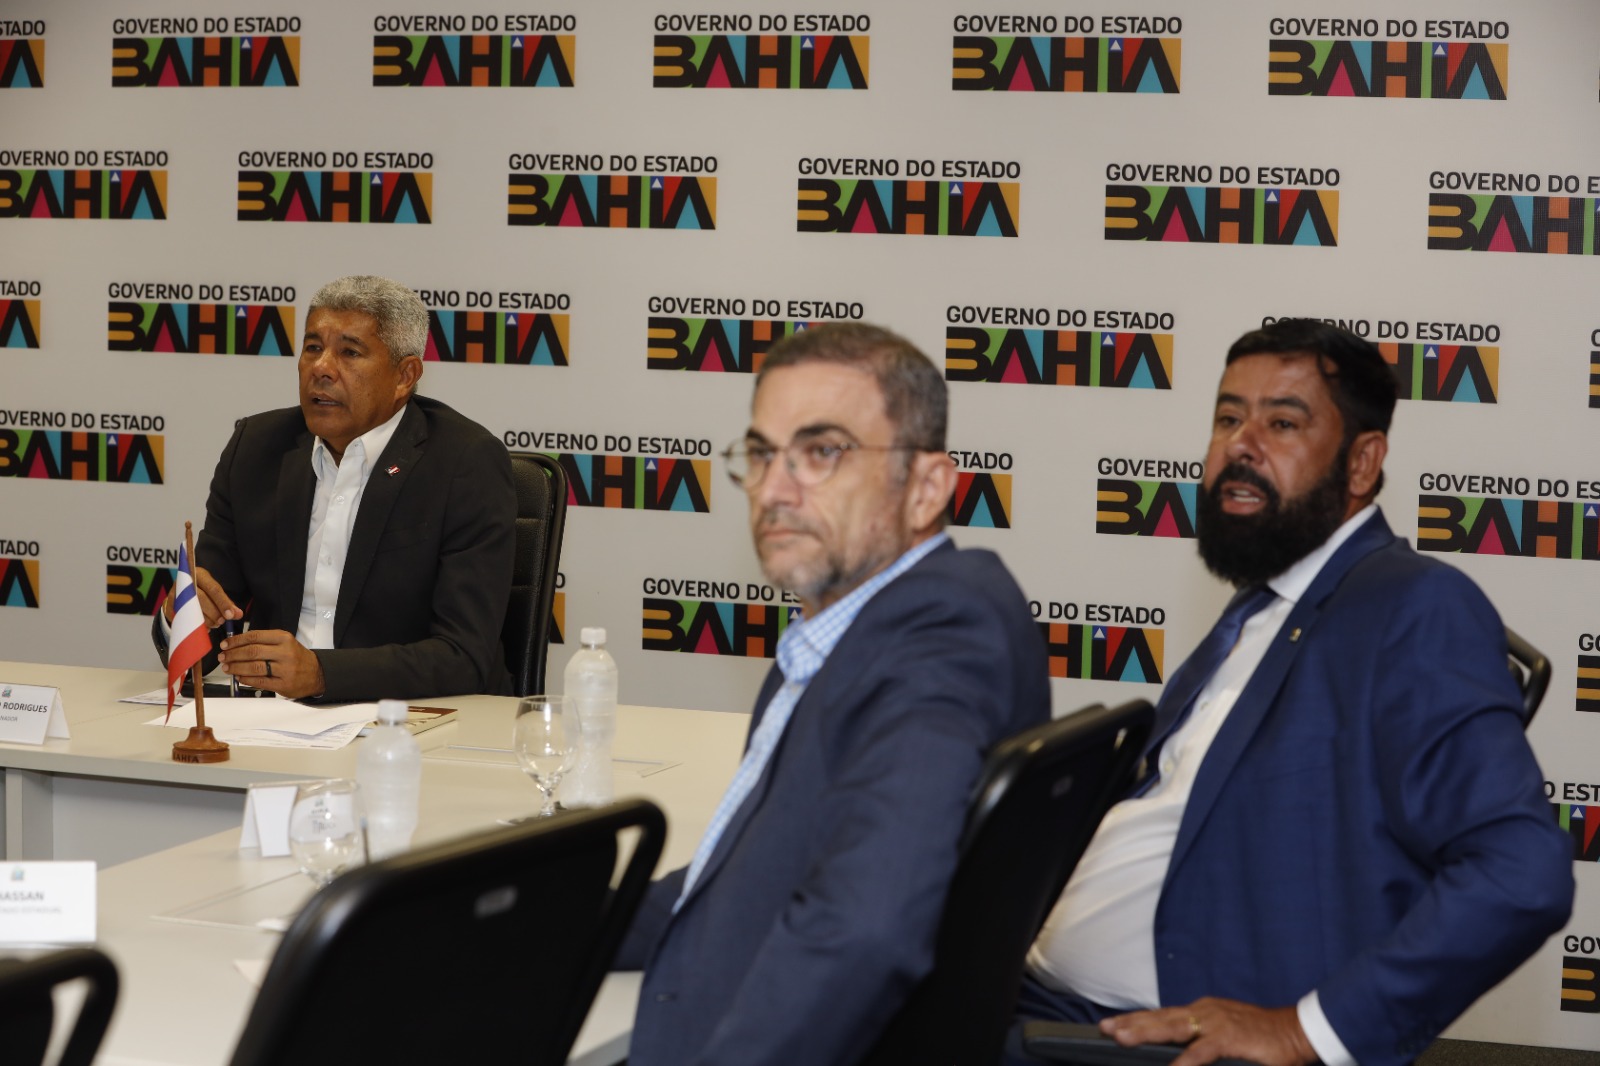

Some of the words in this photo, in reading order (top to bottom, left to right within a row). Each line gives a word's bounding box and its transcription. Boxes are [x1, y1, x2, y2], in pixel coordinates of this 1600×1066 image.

[113, 17, 199, 35] GOVERNO
[203, 16, 229, 34] DO
[234, 16, 302, 34] ESTADO
[373, 15, 467, 33] GOVERNO
[471, 15, 499, 32] DO
[504, 15, 577, 32] ESTADO
[654, 14, 753, 32] GOVERNO
[758, 14, 788, 32] DO
[793, 15, 871, 33] ESTADO
[953, 15, 1058, 34] GOVERNO
[1064, 15, 1095, 34] DO
[1101, 16, 1183, 35] ESTADO
[1269, 17, 1379, 37] GOVERNO
[1386, 19, 1418, 38] DO
[1424, 20, 1510, 40] ESTADO
[112, 36, 301, 88] BAHIA
[373, 34, 576, 88] BAHIA
[653, 35, 870, 90] BAHIA
[952, 36, 1182, 94] BAHIA
[1268, 39, 1510, 100] BAHIA
[0, 150, 70, 167] OVERNO
[74, 151, 99, 167] DO
[103, 151, 169, 168] ESTADO
[238, 151, 327, 169] GOVERNO
[332, 152, 359, 169] DO
[363, 152, 434, 170] ESTADO
[508, 153, 604, 172] GOVERNO
[609, 154, 638, 172] DO
[643, 155, 718, 174] ESTADO
[798, 157, 900, 177] GOVERNO
[905, 159, 936, 178] DO
[941, 160, 1021, 179] ESTADO
[1105, 164, 1213, 184] GOVERNO
[1219, 165, 1251, 185] DO
[1257, 167, 1340, 187] ESTADO
[1429, 171, 1541, 193] GOVERNO
[1548, 175, 1580, 194] DO
[237, 171, 433, 224] BAHIA
[508, 173, 718, 230] BAHIA
[797, 178, 1020, 238] BAHIA
[1104, 184, 1340, 247] BAHIA
[0, 280, 42, 297] TADO
[108, 283, 194, 301] GOVERNO
[199, 285, 224, 301] DO
[228, 285, 297, 303] ESTADO
[466, 291, 493, 308] DO
[498, 291, 571, 311] ESTADO
[648, 296, 746, 316] GOVERNO
[752, 299, 781, 318] DO
[787, 300, 864, 320] ESTADO
[107, 302, 296, 357] BAHIA
[946, 305, 1051, 327] GOVERNO
[1056, 309, 1087, 328] DO
[1093, 310, 1175, 331] ESTADO
[423, 309, 570, 367] AHIA
[1377, 320, 1409, 340] DO
[1415, 321, 1501, 344] ESTADO
[647, 316, 820, 373] BAH
[945, 326, 1175, 390] BAHIA
[0, 410, 67, 428] OVERNO
[71, 413, 96, 430] DO
[100, 413, 165, 432] ESTADO
[503, 430, 598, 452] GOVERNO
[604, 434, 632, 453] DO
[637, 437, 712, 457] ESTADO
[947, 451, 1014, 471] STADO
[1097, 457, 1204, 480] GOVERNO
[1419, 472, 1531, 496] GOVERNO
[1537, 478, 1570, 498] DO
[1417, 494, 1600, 562] BAHI
[0, 539, 40, 557] TADO
[106, 546, 178, 566] GOVERN
[642, 578, 741, 600] GOVERNO
[746, 583, 775, 602] DO
[1048, 602, 1079, 621] DO
[1085, 604, 1166, 626] ESTADO
[642, 597, 780, 659] BAH
[2, 701, 48, 714] RODRIGUES
